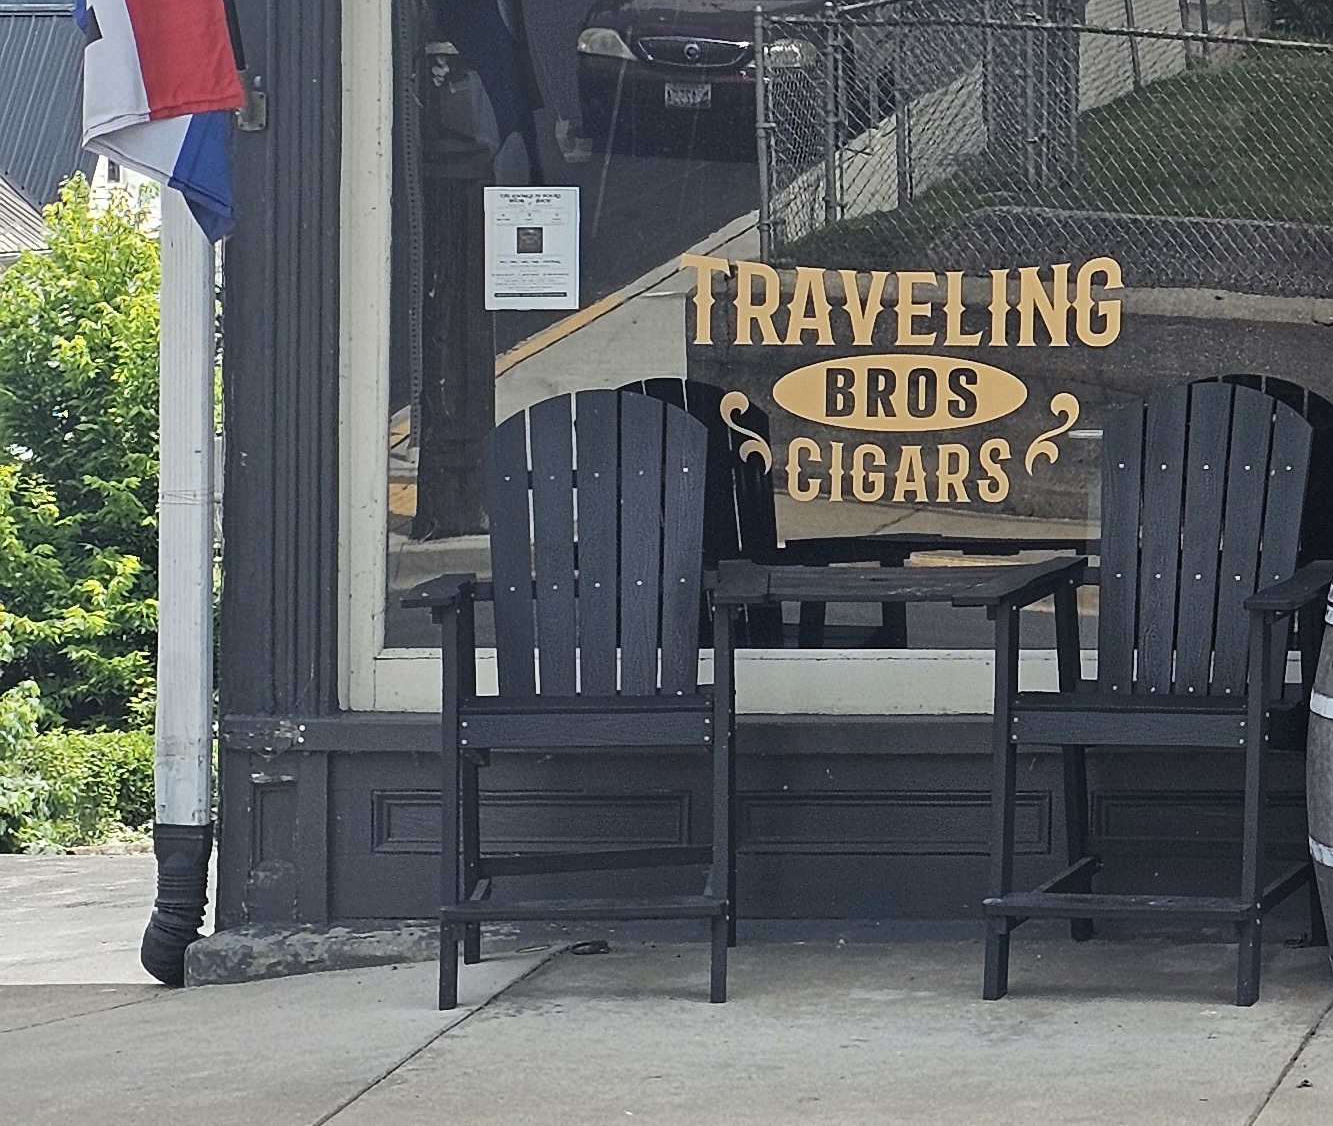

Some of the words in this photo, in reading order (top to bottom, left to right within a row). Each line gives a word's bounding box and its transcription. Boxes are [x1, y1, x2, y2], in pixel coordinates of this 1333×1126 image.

[679, 253, 1125, 348] TRAVELING
[825, 367, 978, 419] BROS
[785, 437, 1012, 503] CIGARS
